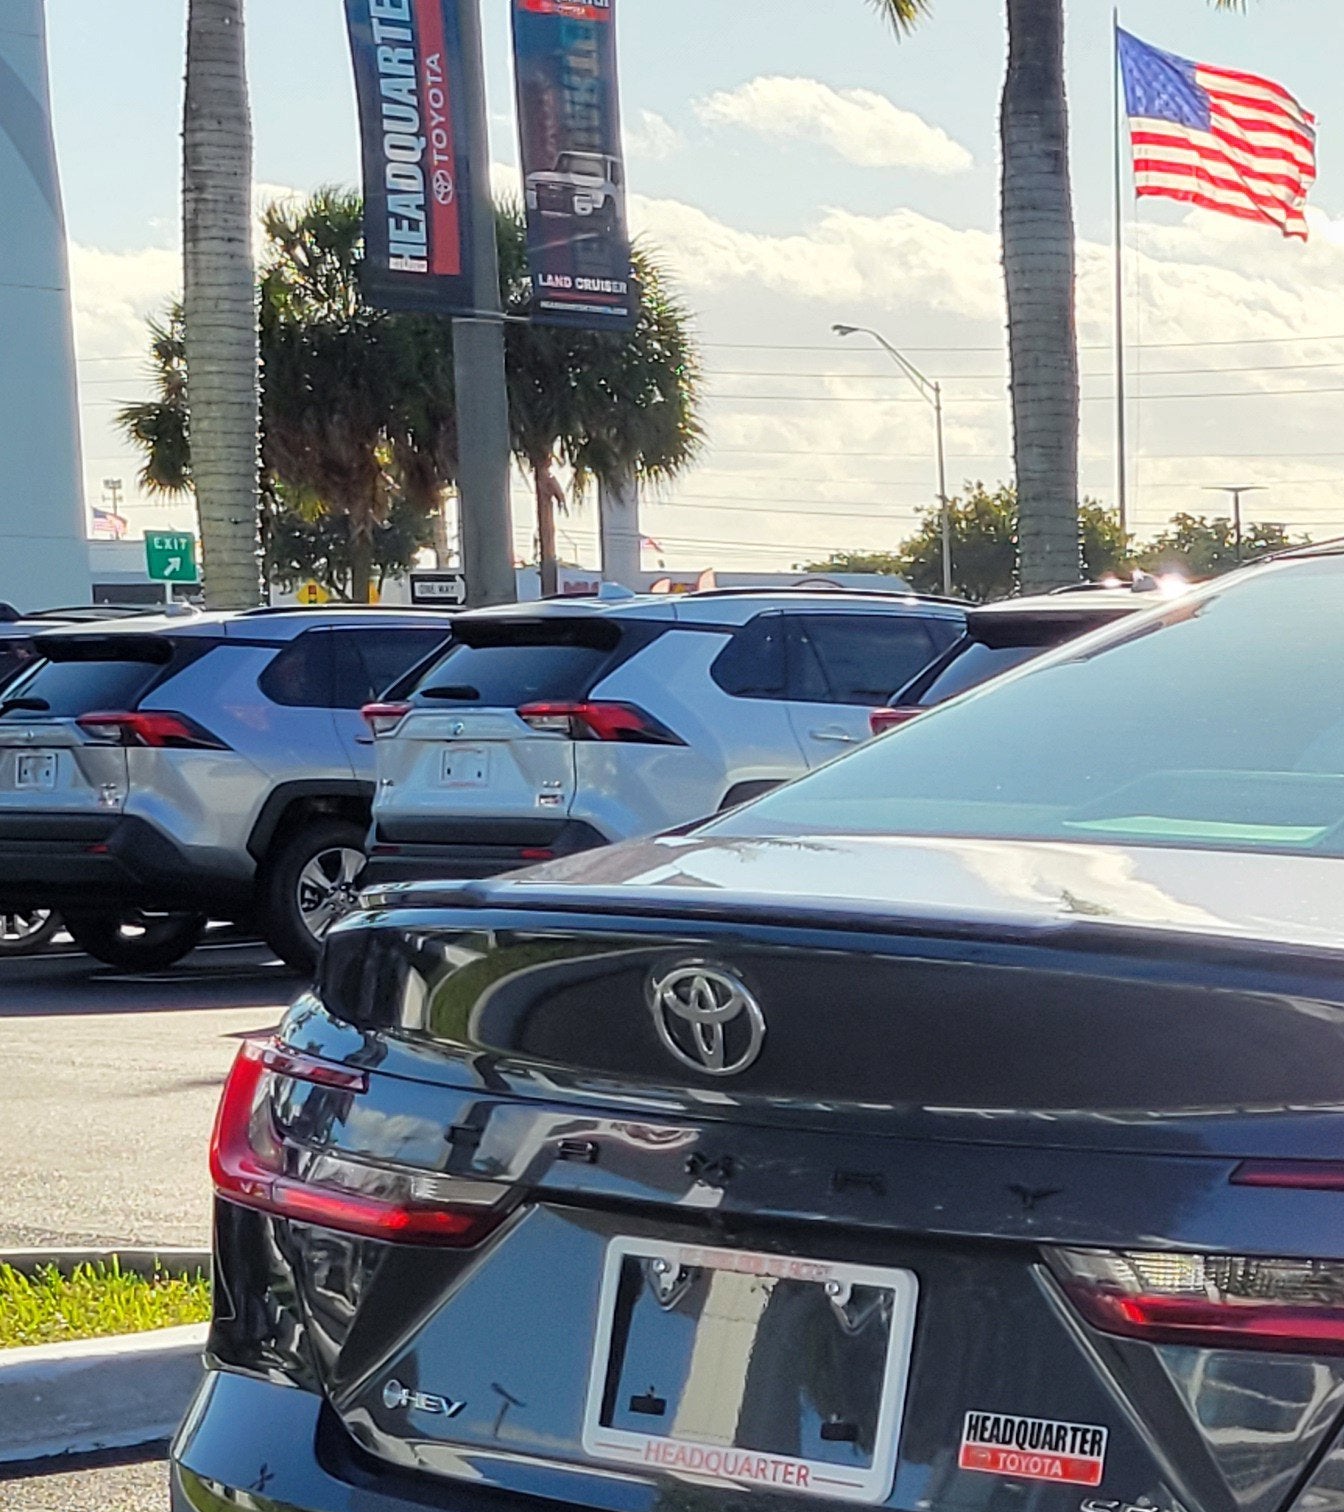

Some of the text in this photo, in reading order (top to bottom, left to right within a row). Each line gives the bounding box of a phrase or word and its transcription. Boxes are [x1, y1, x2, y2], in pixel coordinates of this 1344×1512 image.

[425, 53, 450, 166] TOYOTA
[538, 273, 628, 295] LAND CRUISER
[153, 537, 188, 550] EXIT
[965, 1413, 1104, 1457] HEADQUARTER
[644, 1440, 811, 1487] HEADQUARTER
[997, 1452, 1064, 1477] TOYOTA
